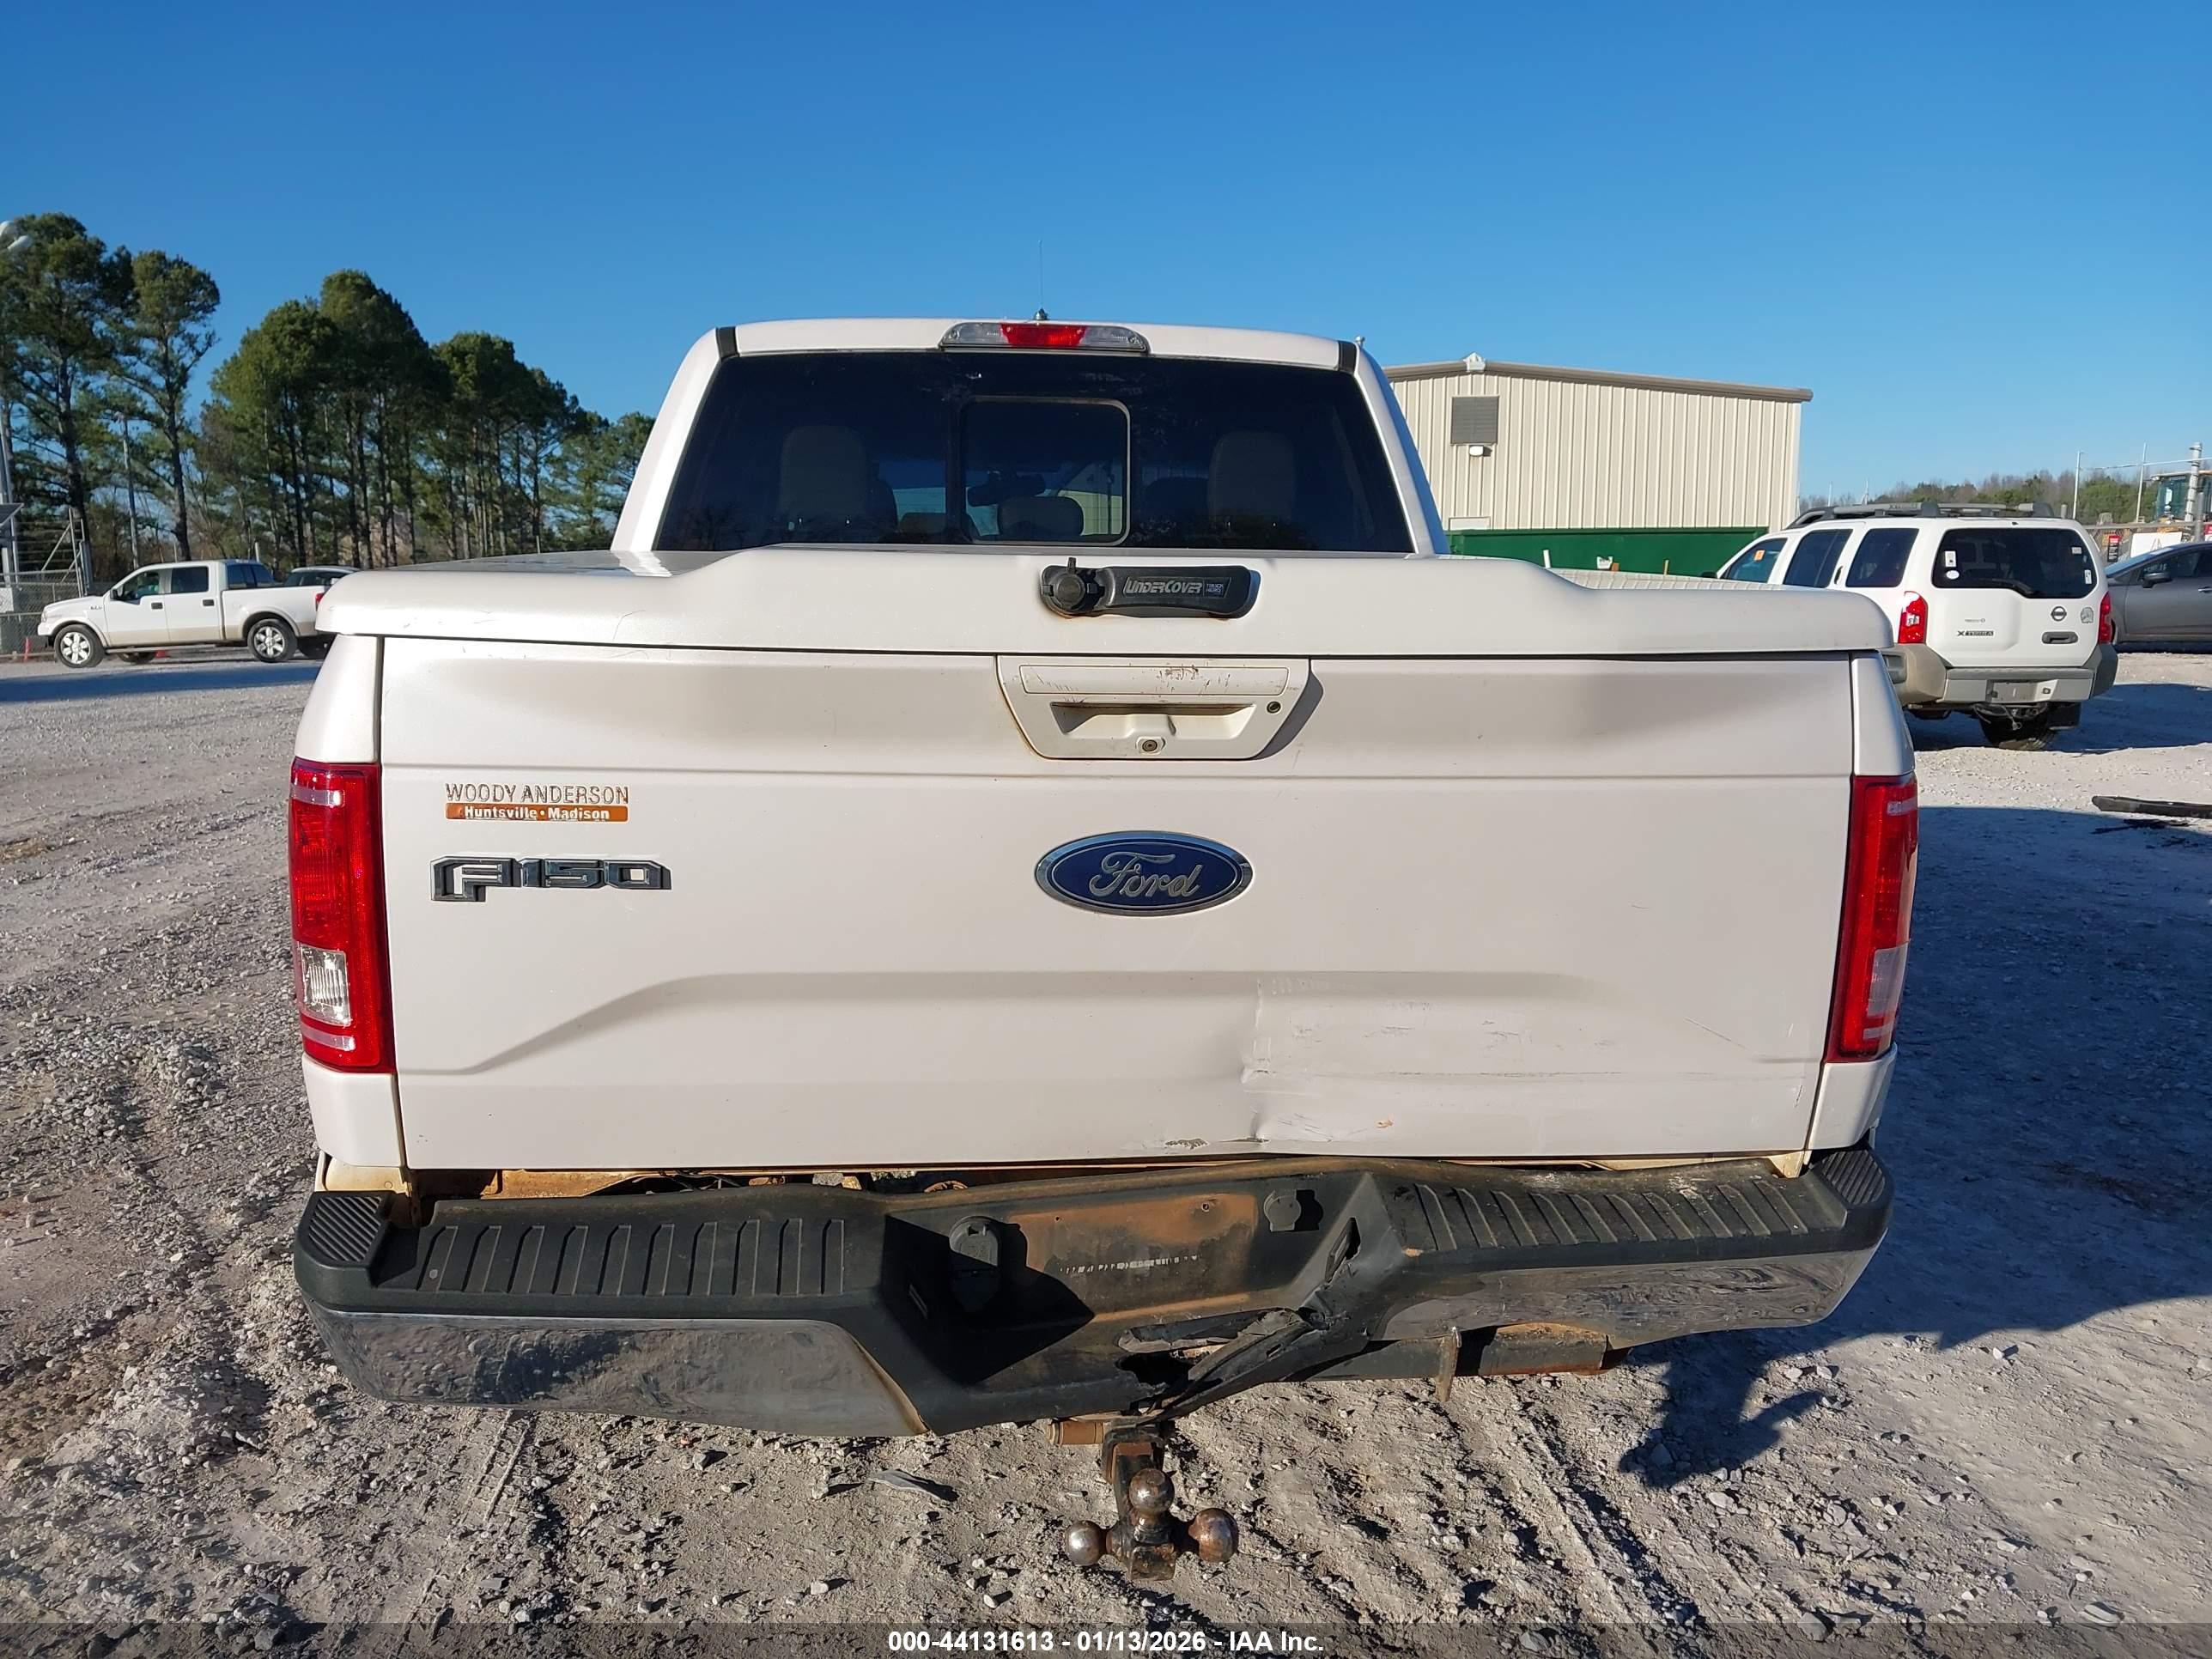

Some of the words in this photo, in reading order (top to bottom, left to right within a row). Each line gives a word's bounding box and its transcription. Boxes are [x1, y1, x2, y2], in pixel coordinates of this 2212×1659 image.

[445, 783, 516, 803] WOODY
[521, 785, 629, 805] ANDERSON
[464, 805, 538, 819] Huntsville
[547, 807, 610, 820] Madison
[1089, 851, 1203, 897] Ford
